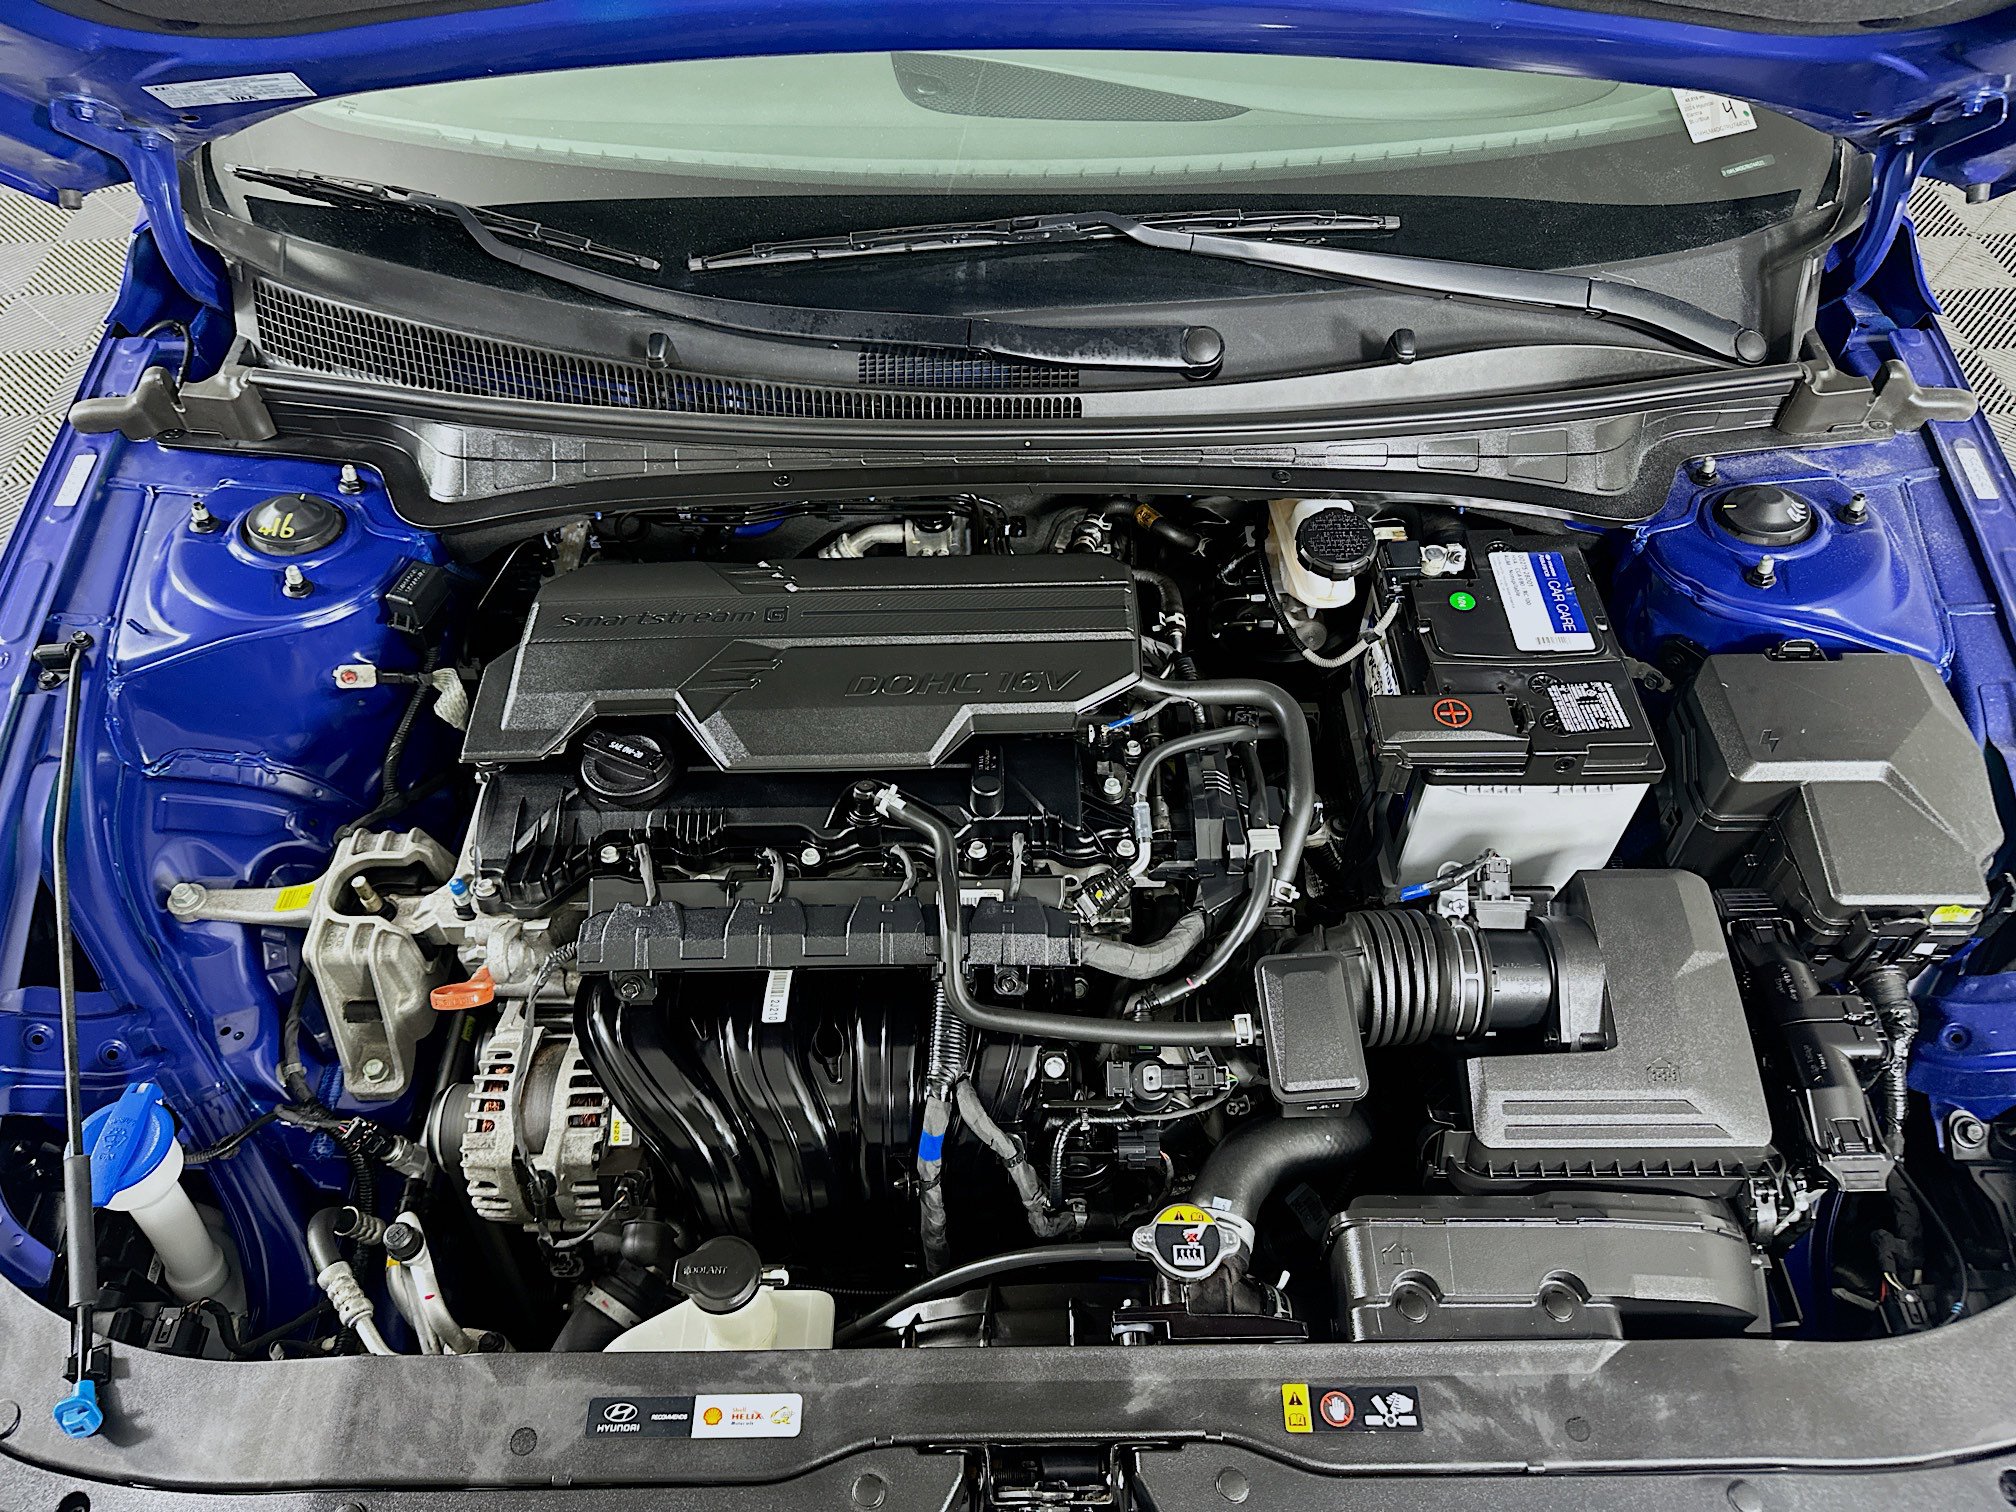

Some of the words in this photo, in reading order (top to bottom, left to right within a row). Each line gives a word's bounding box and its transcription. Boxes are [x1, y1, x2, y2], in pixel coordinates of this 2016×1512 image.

[1722, 100, 1737, 119] 4
[1547, 580, 1566, 602] CAR
[553, 609, 757, 629] Smartstream
[1556, 604, 1577, 632] CARE
[844, 672, 989, 697] DOHC
[998, 670, 1082, 693] 16V
[608, 741, 625, 752] SAE
[732, 1412, 762, 1420] HELIX
[596, 1423, 640, 1433] HYUNDAI
